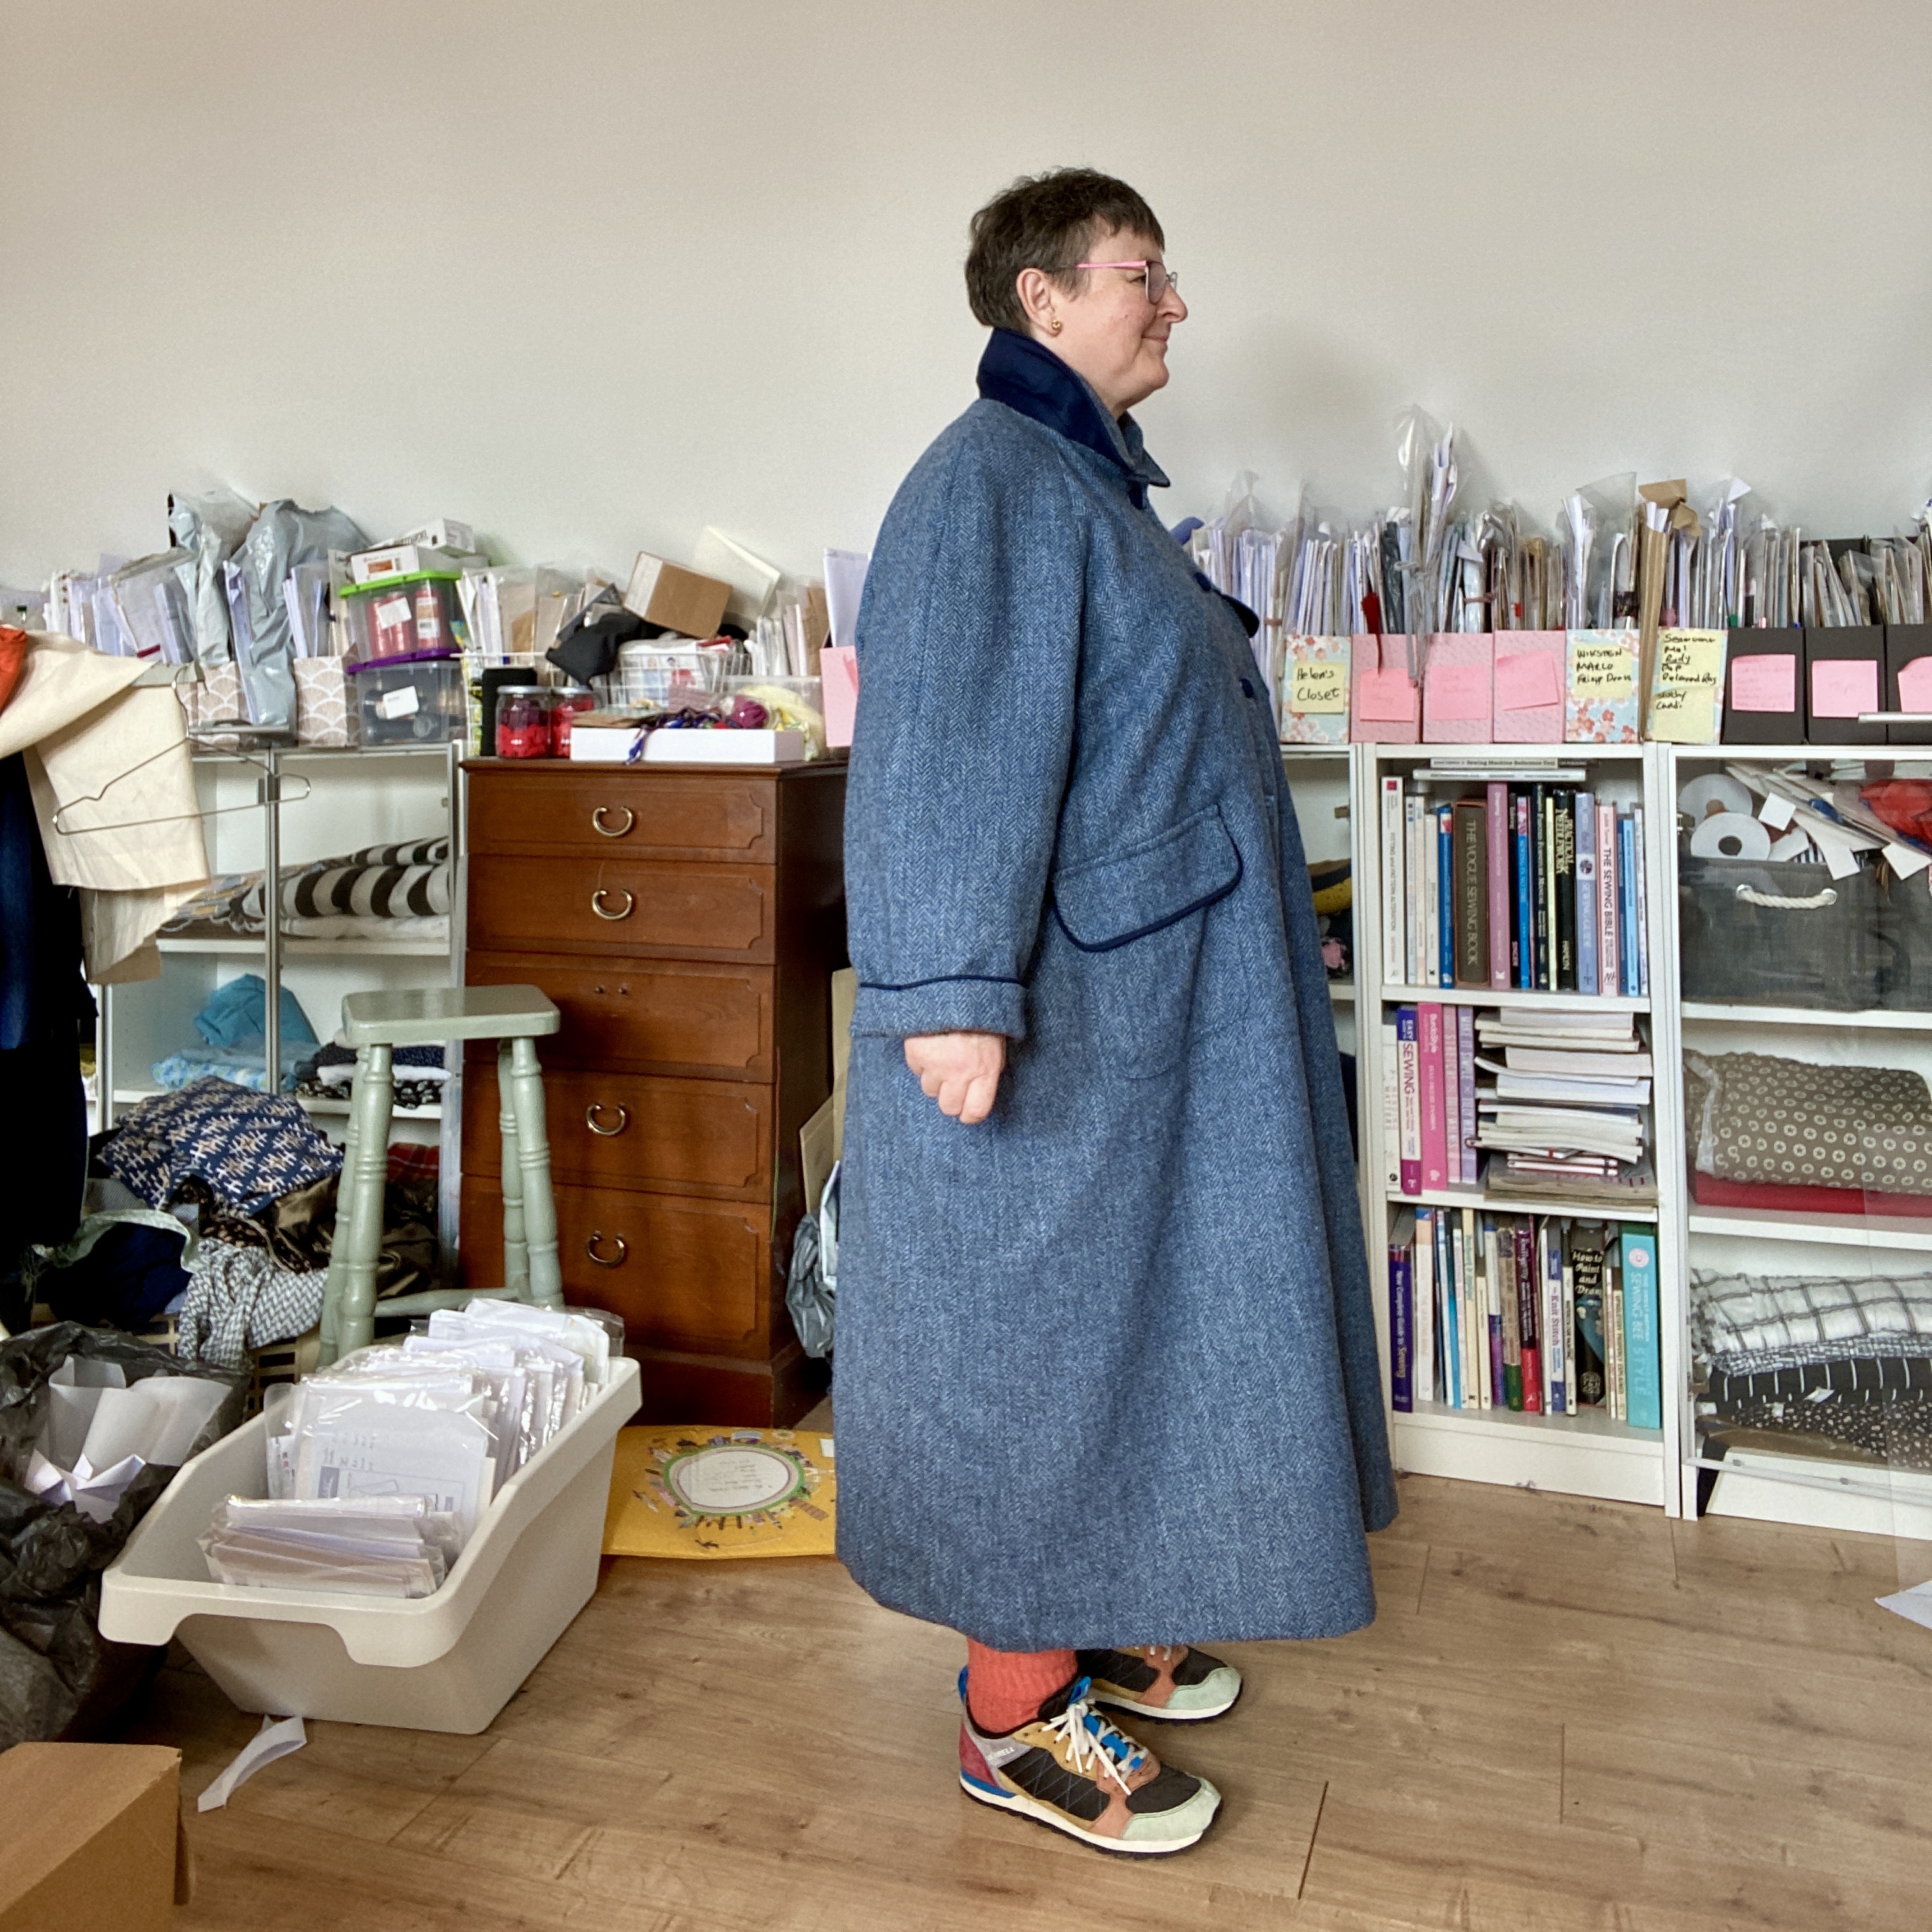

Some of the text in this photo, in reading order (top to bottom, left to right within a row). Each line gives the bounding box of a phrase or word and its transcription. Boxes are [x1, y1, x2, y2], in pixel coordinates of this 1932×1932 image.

[1296, 666, 1335, 681] Helen's
[1297, 686, 1340, 701] Closet
[1556, 808, 1569, 875] NEEDLEWORK
[1565, 819, 1574, 864] PRACTICAL
[1604, 848, 1612, 867] THE
[1466, 820, 1478, 965] THE VOGUE SEWING BOOK
[1604, 869, 1613, 908] SEWING
[1605, 910, 1614, 937] BIBLE
[1403, 1043, 1415, 1094] SEWING
[1572, 1252, 1593, 1262] How
[1578, 1274, 1597, 1284] and
[1551, 1295, 1560, 1315] Knit
[1631, 1273, 1644, 1340] SEWING BEE
[1551, 1317, 1561, 1346] Stitch
[1396, 1346, 1407, 1377] Sewing
[1634, 1347, 1648, 1396] STYLE
